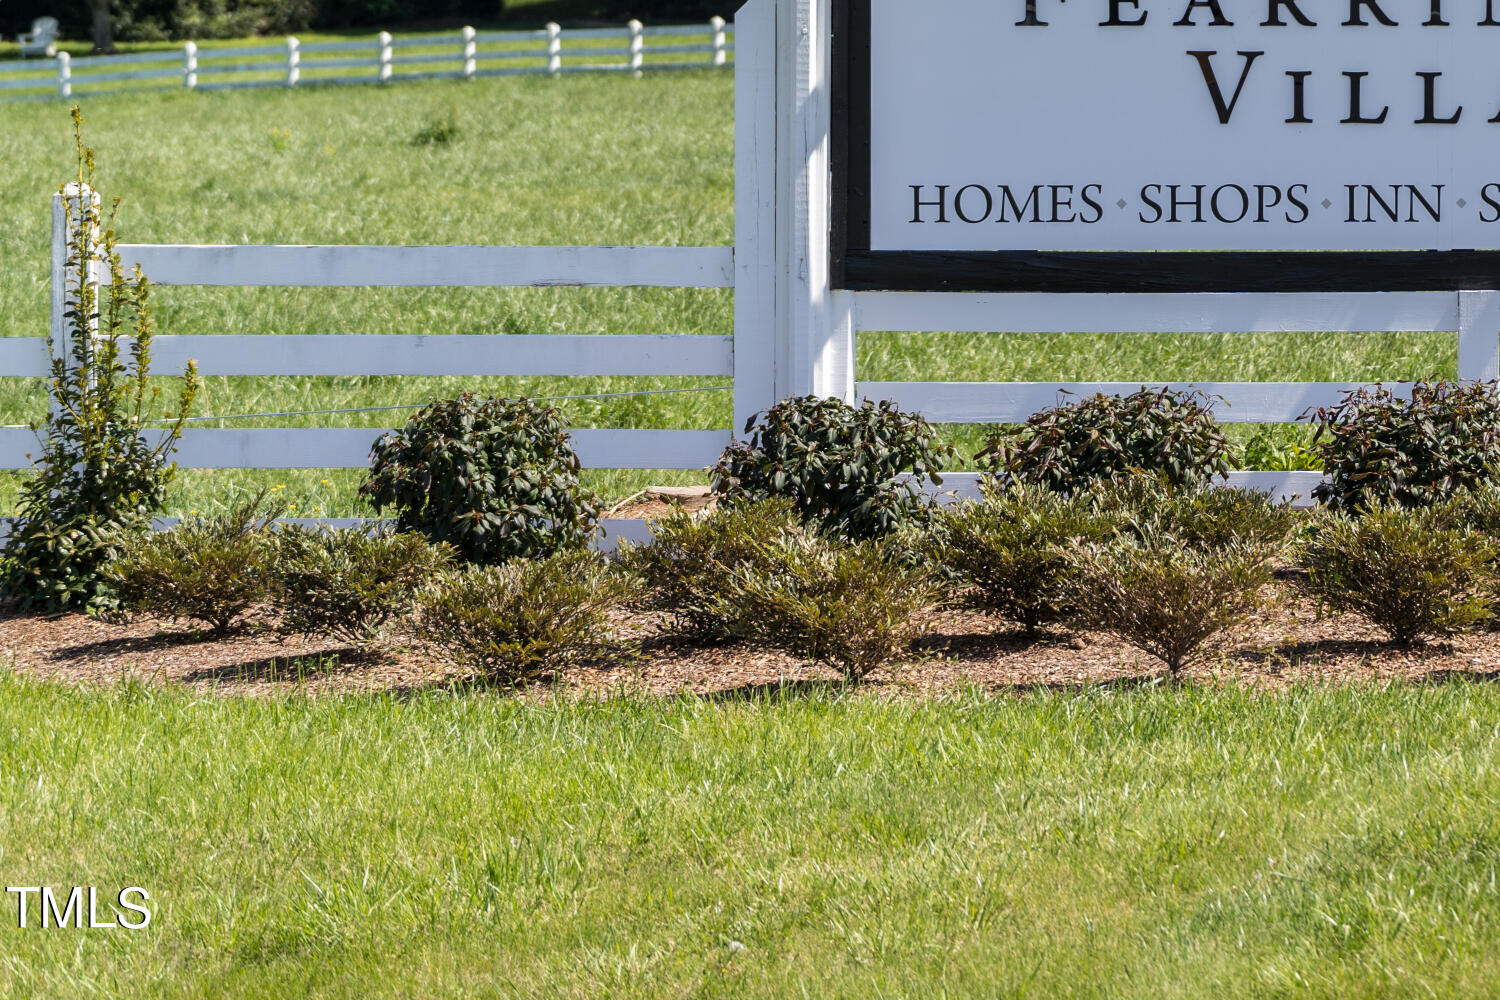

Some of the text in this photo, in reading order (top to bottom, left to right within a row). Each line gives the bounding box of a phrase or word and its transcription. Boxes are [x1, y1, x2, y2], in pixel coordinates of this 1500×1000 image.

[908, 184, 1104, 223] HOMES
[1138, 183, 1310, 223] SHOPS
[1343, 184, 1446, 223] INN
